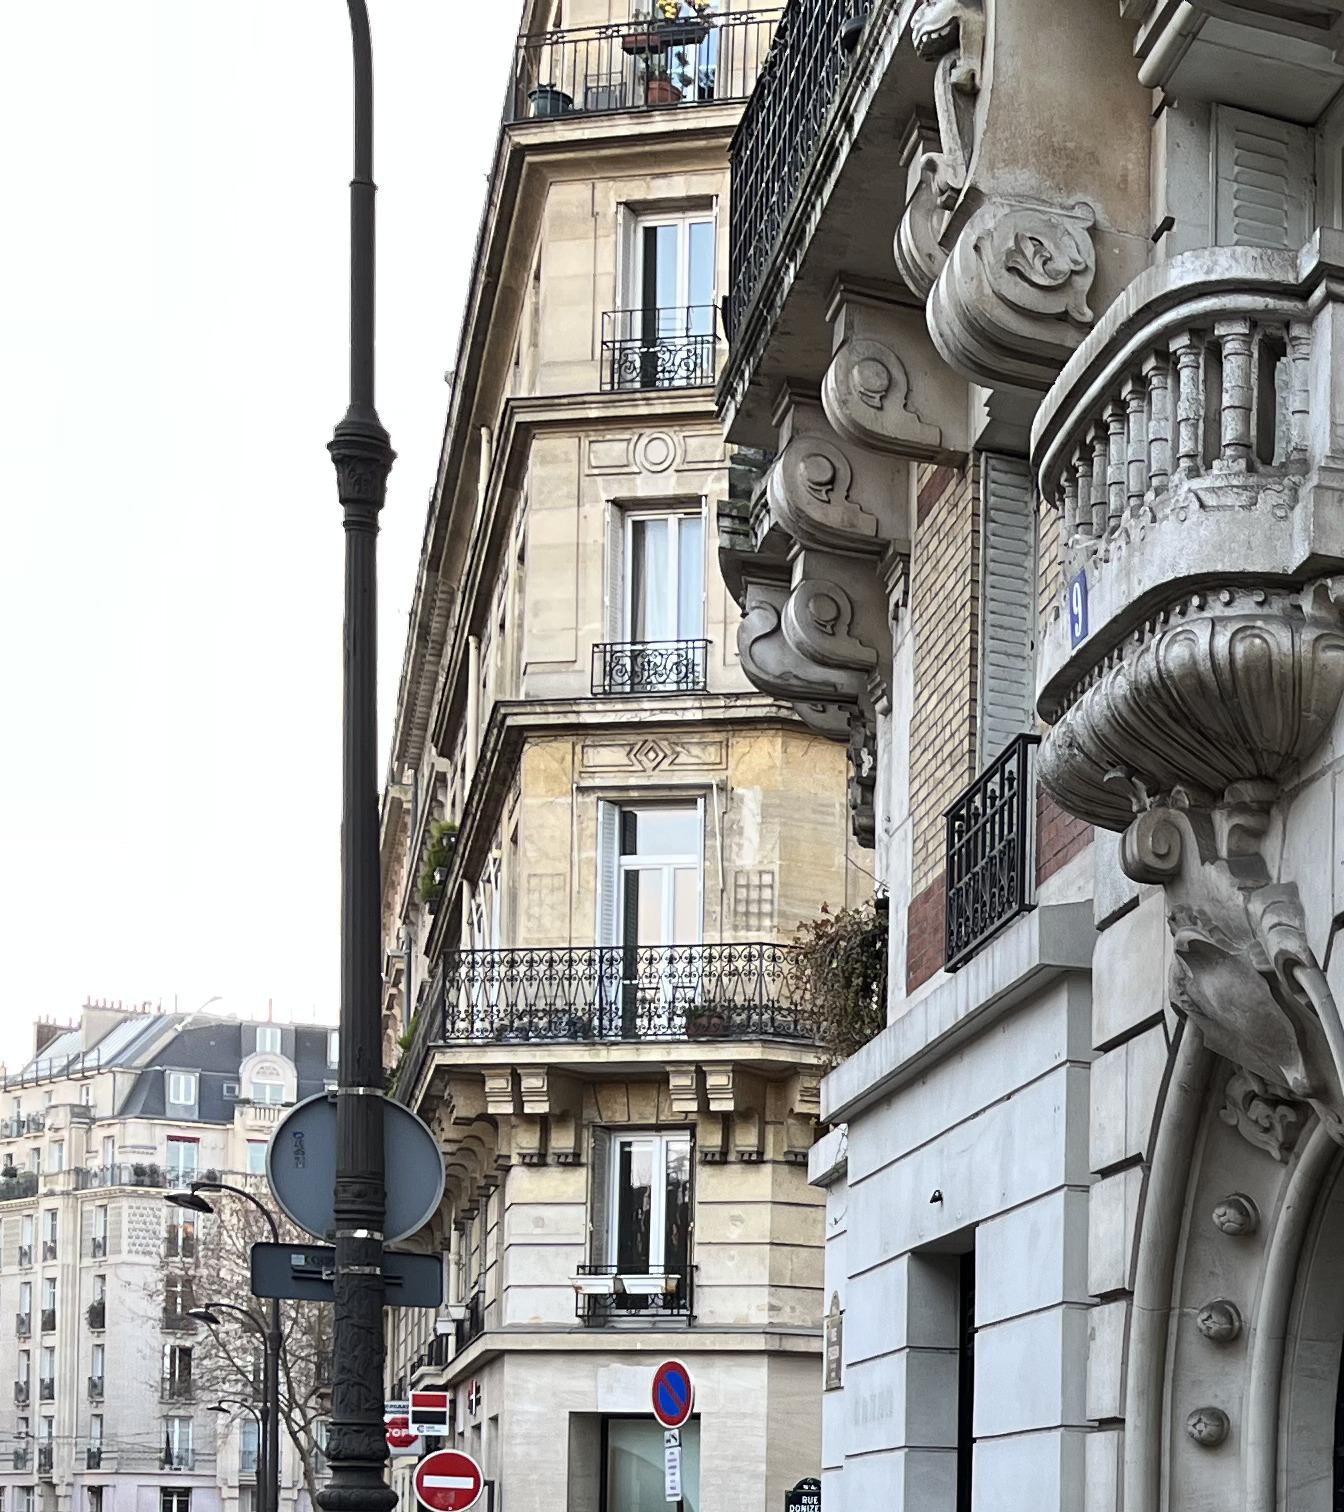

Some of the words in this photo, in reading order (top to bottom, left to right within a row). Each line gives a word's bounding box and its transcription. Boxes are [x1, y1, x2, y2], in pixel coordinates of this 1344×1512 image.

[1072, 582, 1082, 638] 9
[801, 1495, 819, 1505] RUE
[789, 1504, 820, 1512] DONIZE
